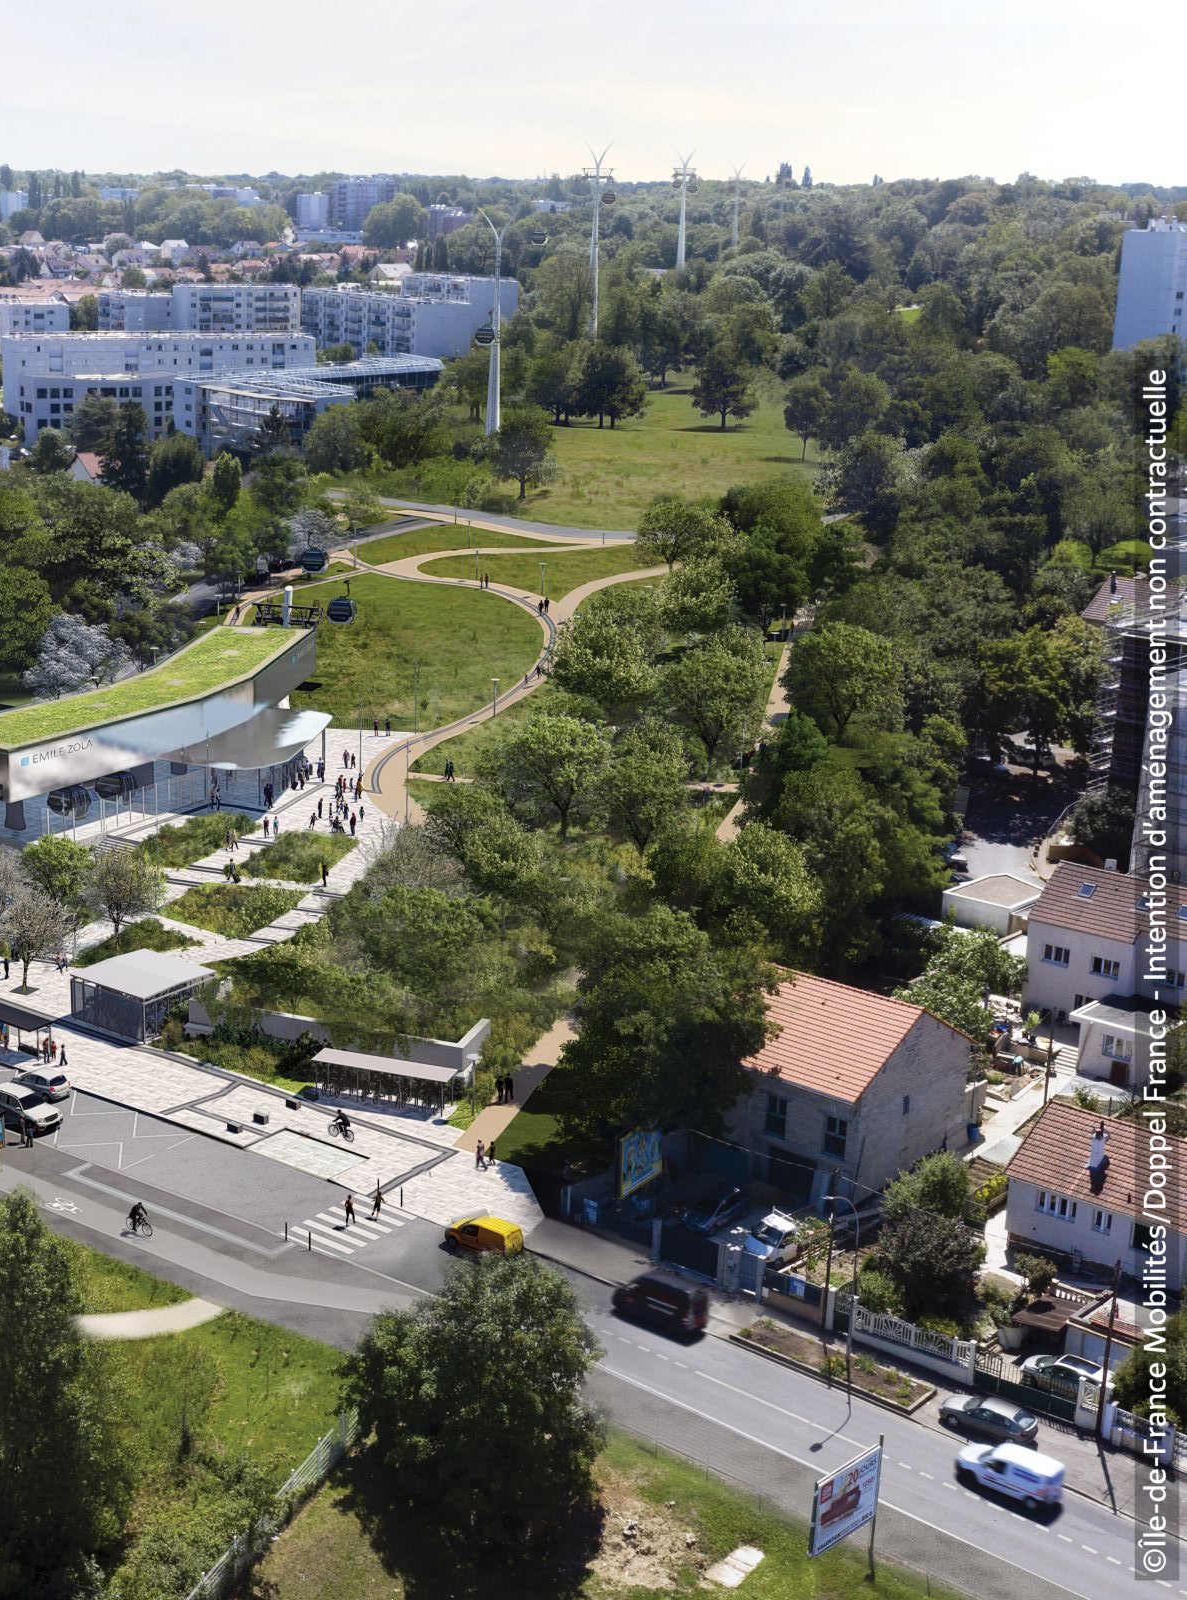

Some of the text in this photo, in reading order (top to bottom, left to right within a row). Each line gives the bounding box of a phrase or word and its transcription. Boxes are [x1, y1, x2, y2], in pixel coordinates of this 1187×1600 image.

[32, 739, 93, 764] EMILE ZOLA
[847, 1468, 859, 1486] 20
